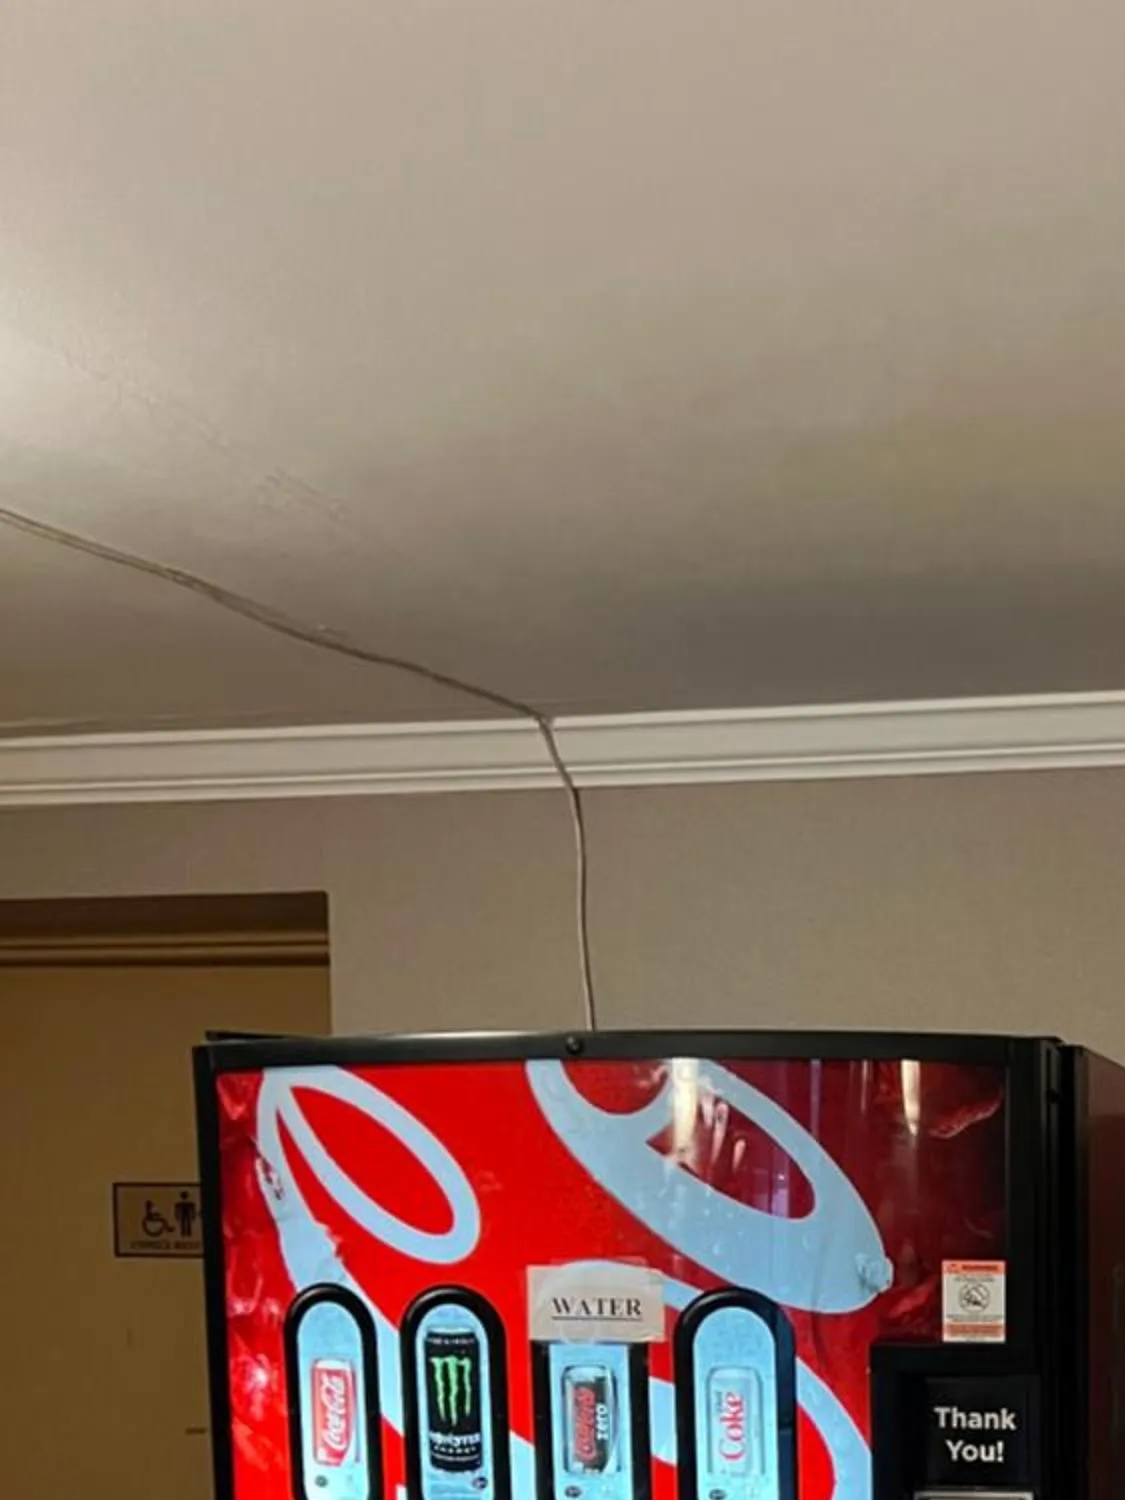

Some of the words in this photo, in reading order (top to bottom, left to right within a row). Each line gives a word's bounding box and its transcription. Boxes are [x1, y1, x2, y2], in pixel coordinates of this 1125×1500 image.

[551, 1296, 642, 1316] WATER
[718, 1390, 745, 1461] Coke
[934, 1406, 1017, 1430] Thank
[946, 1440, 1005, 1463] You!
